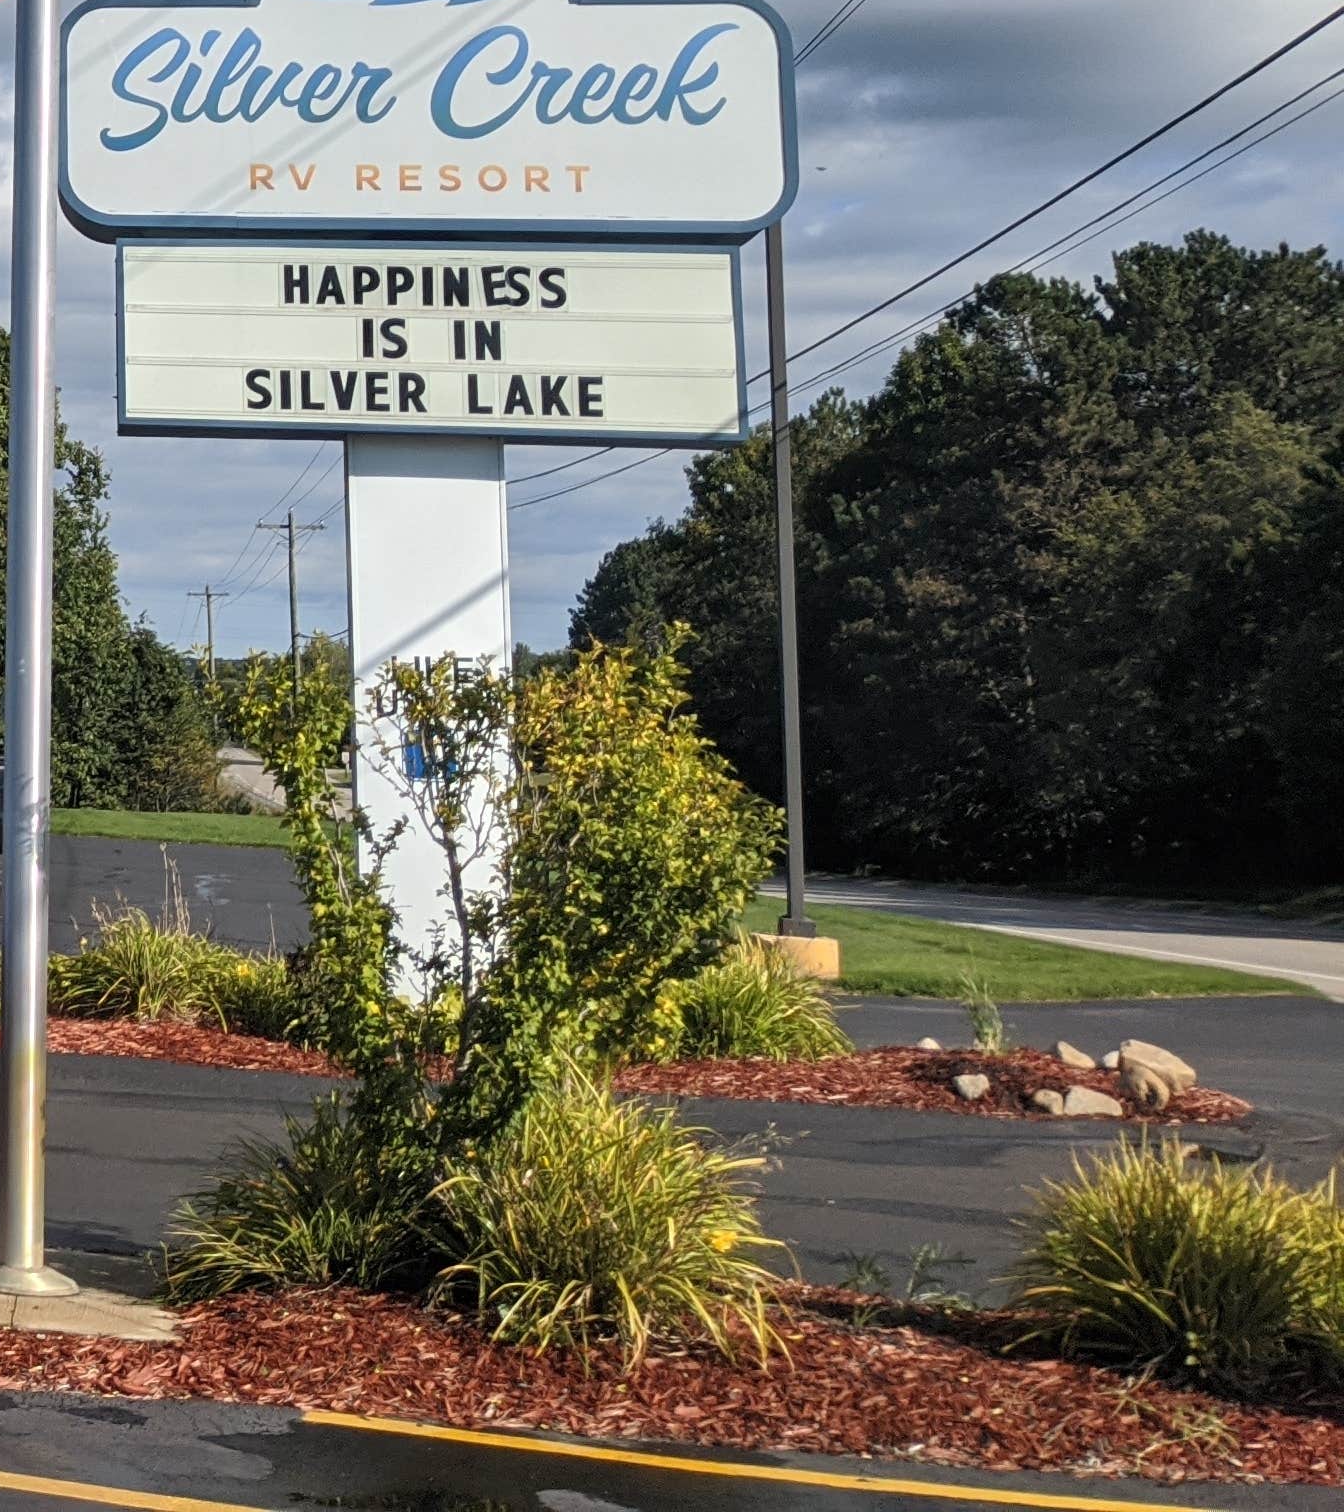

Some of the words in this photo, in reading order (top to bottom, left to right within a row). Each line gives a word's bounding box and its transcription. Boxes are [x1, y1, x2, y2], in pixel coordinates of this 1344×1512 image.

[100, 27, 396, 152] Silver
[430, 24, 740, 140] Creek
[249, 163, 316, 191] RV
[355, 164, 592, 193] RESORT
[282, 264, 568, 309] HAPPINESS
[362, 317, 408, 360] IS
[453, 320, 503, 361] IN
[245, 368, 428, 414] SILVER
[467, 373, 604, 418] LAKE
